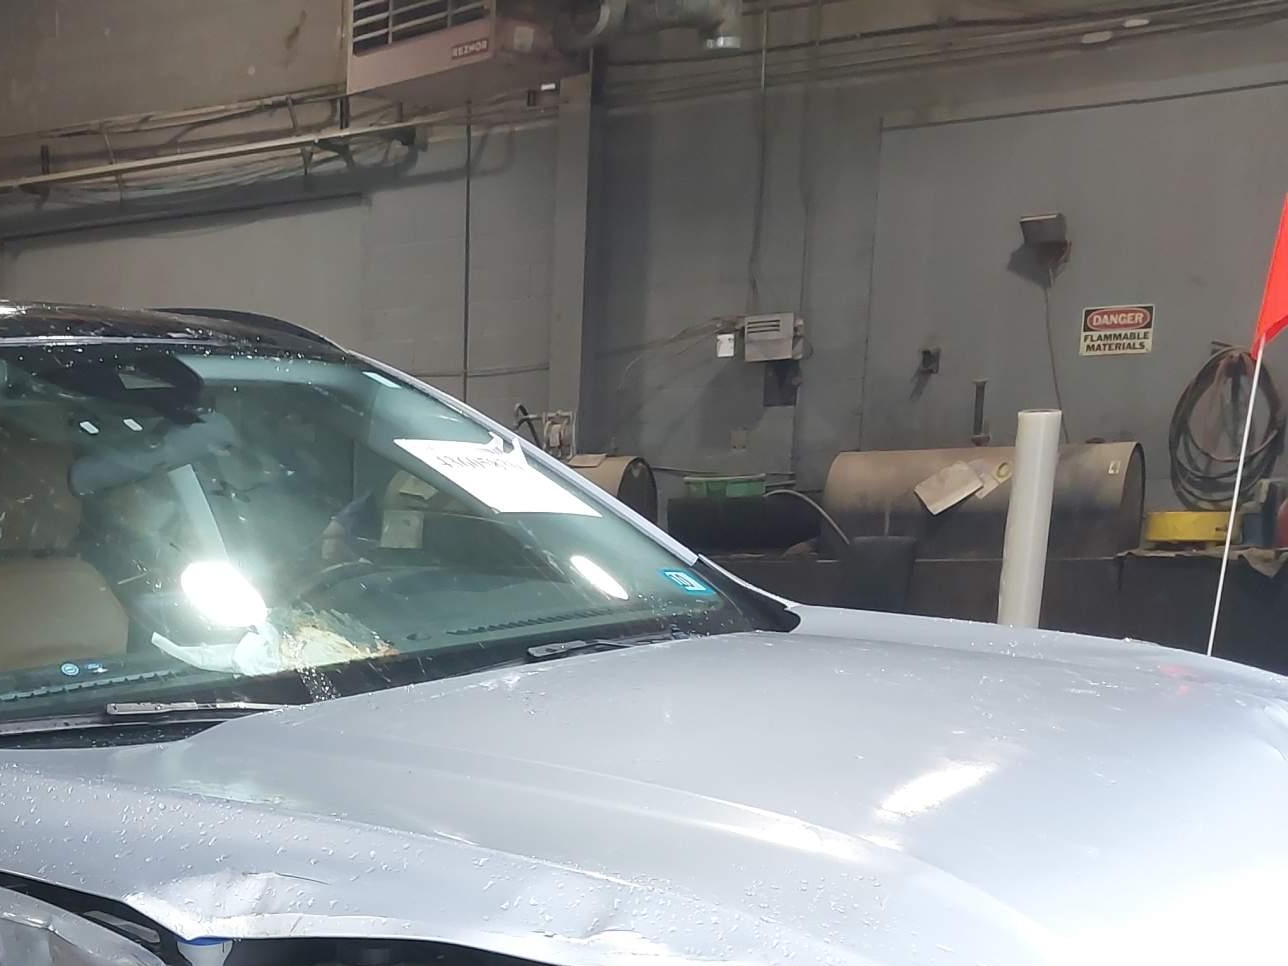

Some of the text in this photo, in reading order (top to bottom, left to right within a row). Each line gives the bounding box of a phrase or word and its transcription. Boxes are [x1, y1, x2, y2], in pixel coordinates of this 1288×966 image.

[1092, 312, 1145, 326] DANGER
[1083, 331, 1150, 342] FLAMMABLE
[1085, 341, 1146, 353] MATERIALS
